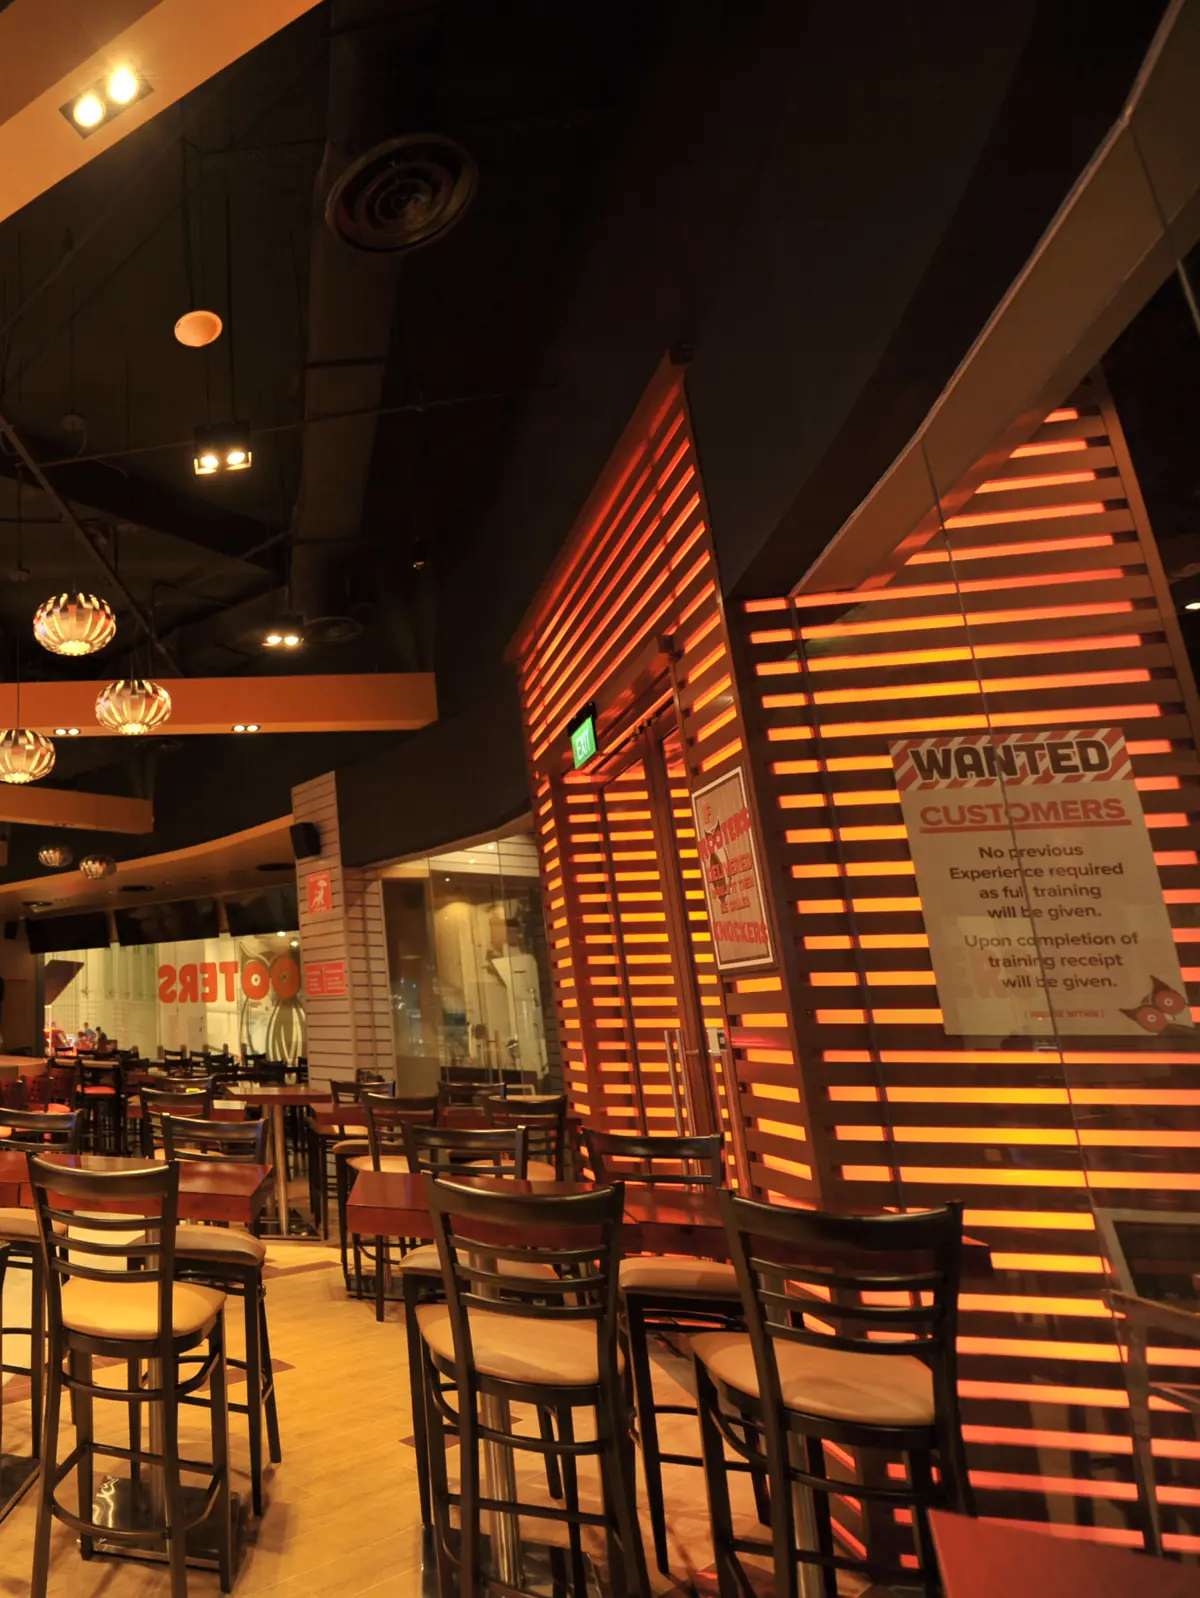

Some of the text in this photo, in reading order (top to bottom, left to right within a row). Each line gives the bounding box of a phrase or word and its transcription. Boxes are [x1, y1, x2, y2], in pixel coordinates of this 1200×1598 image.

[909, 740, 1110, 781] WANTED
[920, 798, 1125, 827] CUSTOMERS
[699, 807, 751, 861] HOOTERS
[978, 845, 1084, 860] No previous
[949, 863, 1124, 881] Experience required
[979, 884, 1102, 899] as ful training
[987, 904, 1102, 921] will be given.
[712, 920, 769, 944] KNOCKERS
[964, 931, 1139, 949] Upon completion of
[988, 953, 1124, 969] training receipt
[1002, 974, 1117, 990] will be given.
